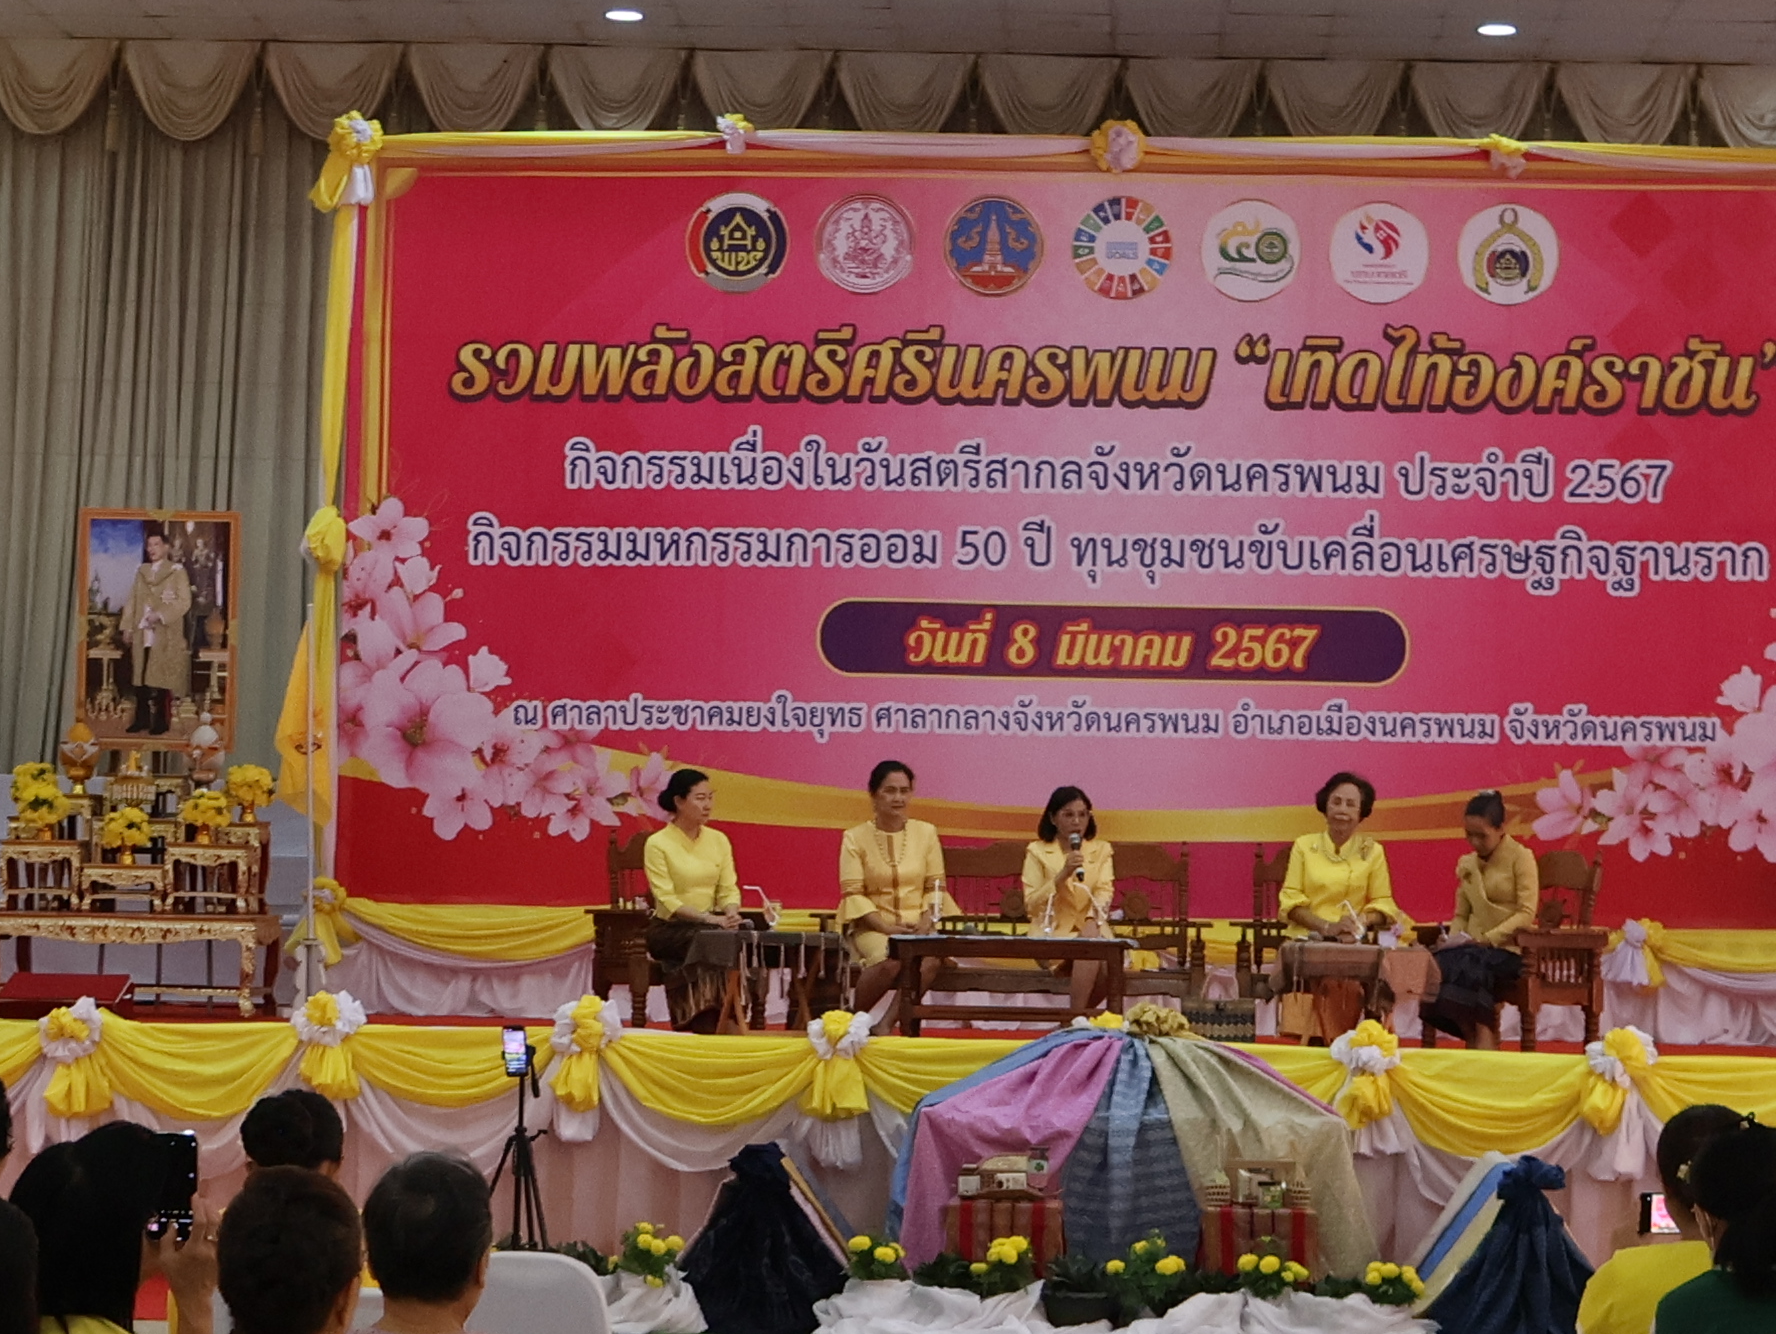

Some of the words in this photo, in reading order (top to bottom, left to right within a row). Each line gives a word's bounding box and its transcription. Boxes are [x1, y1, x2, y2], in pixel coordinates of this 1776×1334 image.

[450, 324, 1215, 408] รวมพลังสตรีศรีนครพนม
[567, 429, 1381, 496] กิจกรรมเนื่องในวันสตรีสากลจังหวัดนครพนม
[1399, 452, 1551, 499] ประจำปี
[1568, 463, 1668, 499] 2567
[470, 515, 939, 566] กิจกรรมมหกรรมการออม
[957, 529, 1007, 567] 50
[1024, 519, 1053, 567] ปี
[1072, 515, 1765, 593] ทุนชุมชนขับเคลื่อนเศรษฐกิจฐานราก
[907, 611, 994, 665] วันที่
[1008, 624, 1037, 665] 8
[1056, 617, 1193, 668] มีนาคม
[1210, 625, 1319, 669] 2567
[513, 703, 540, 728] ณ
[551, 696, 864, 740] ศาลาประชาคมยงใจยุทธ
[875, 699, 1220, 735] ศาลากลางจังหวัดนครพนม
[1231, 702, 1496, 741] อำเภอเมืองนครพนม
[1508, 705, 1717, 743] จังหวัดนครพนม
